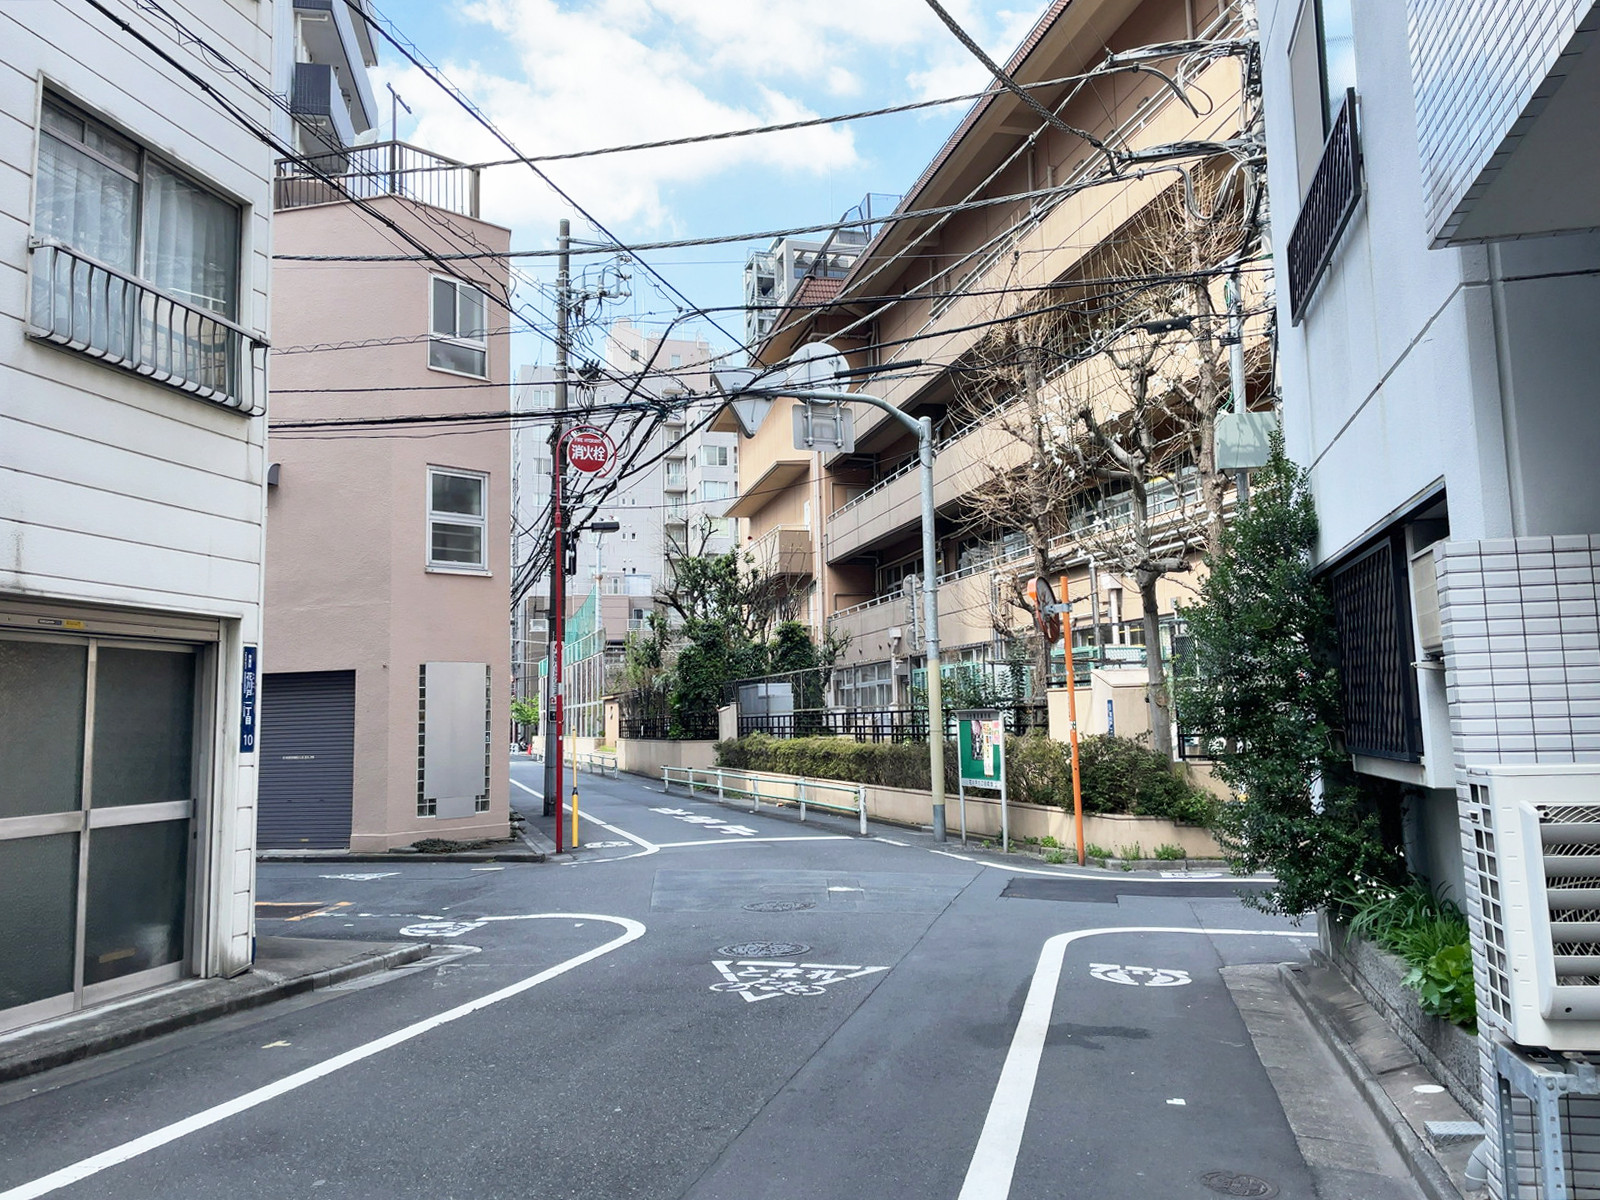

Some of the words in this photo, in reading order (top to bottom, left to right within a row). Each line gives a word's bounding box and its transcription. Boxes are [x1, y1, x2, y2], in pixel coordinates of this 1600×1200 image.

[571, 444, 605, 461] 消火栓
[243, 734, 253, 746] 10
[736, 966, 837, 979] とまれ
